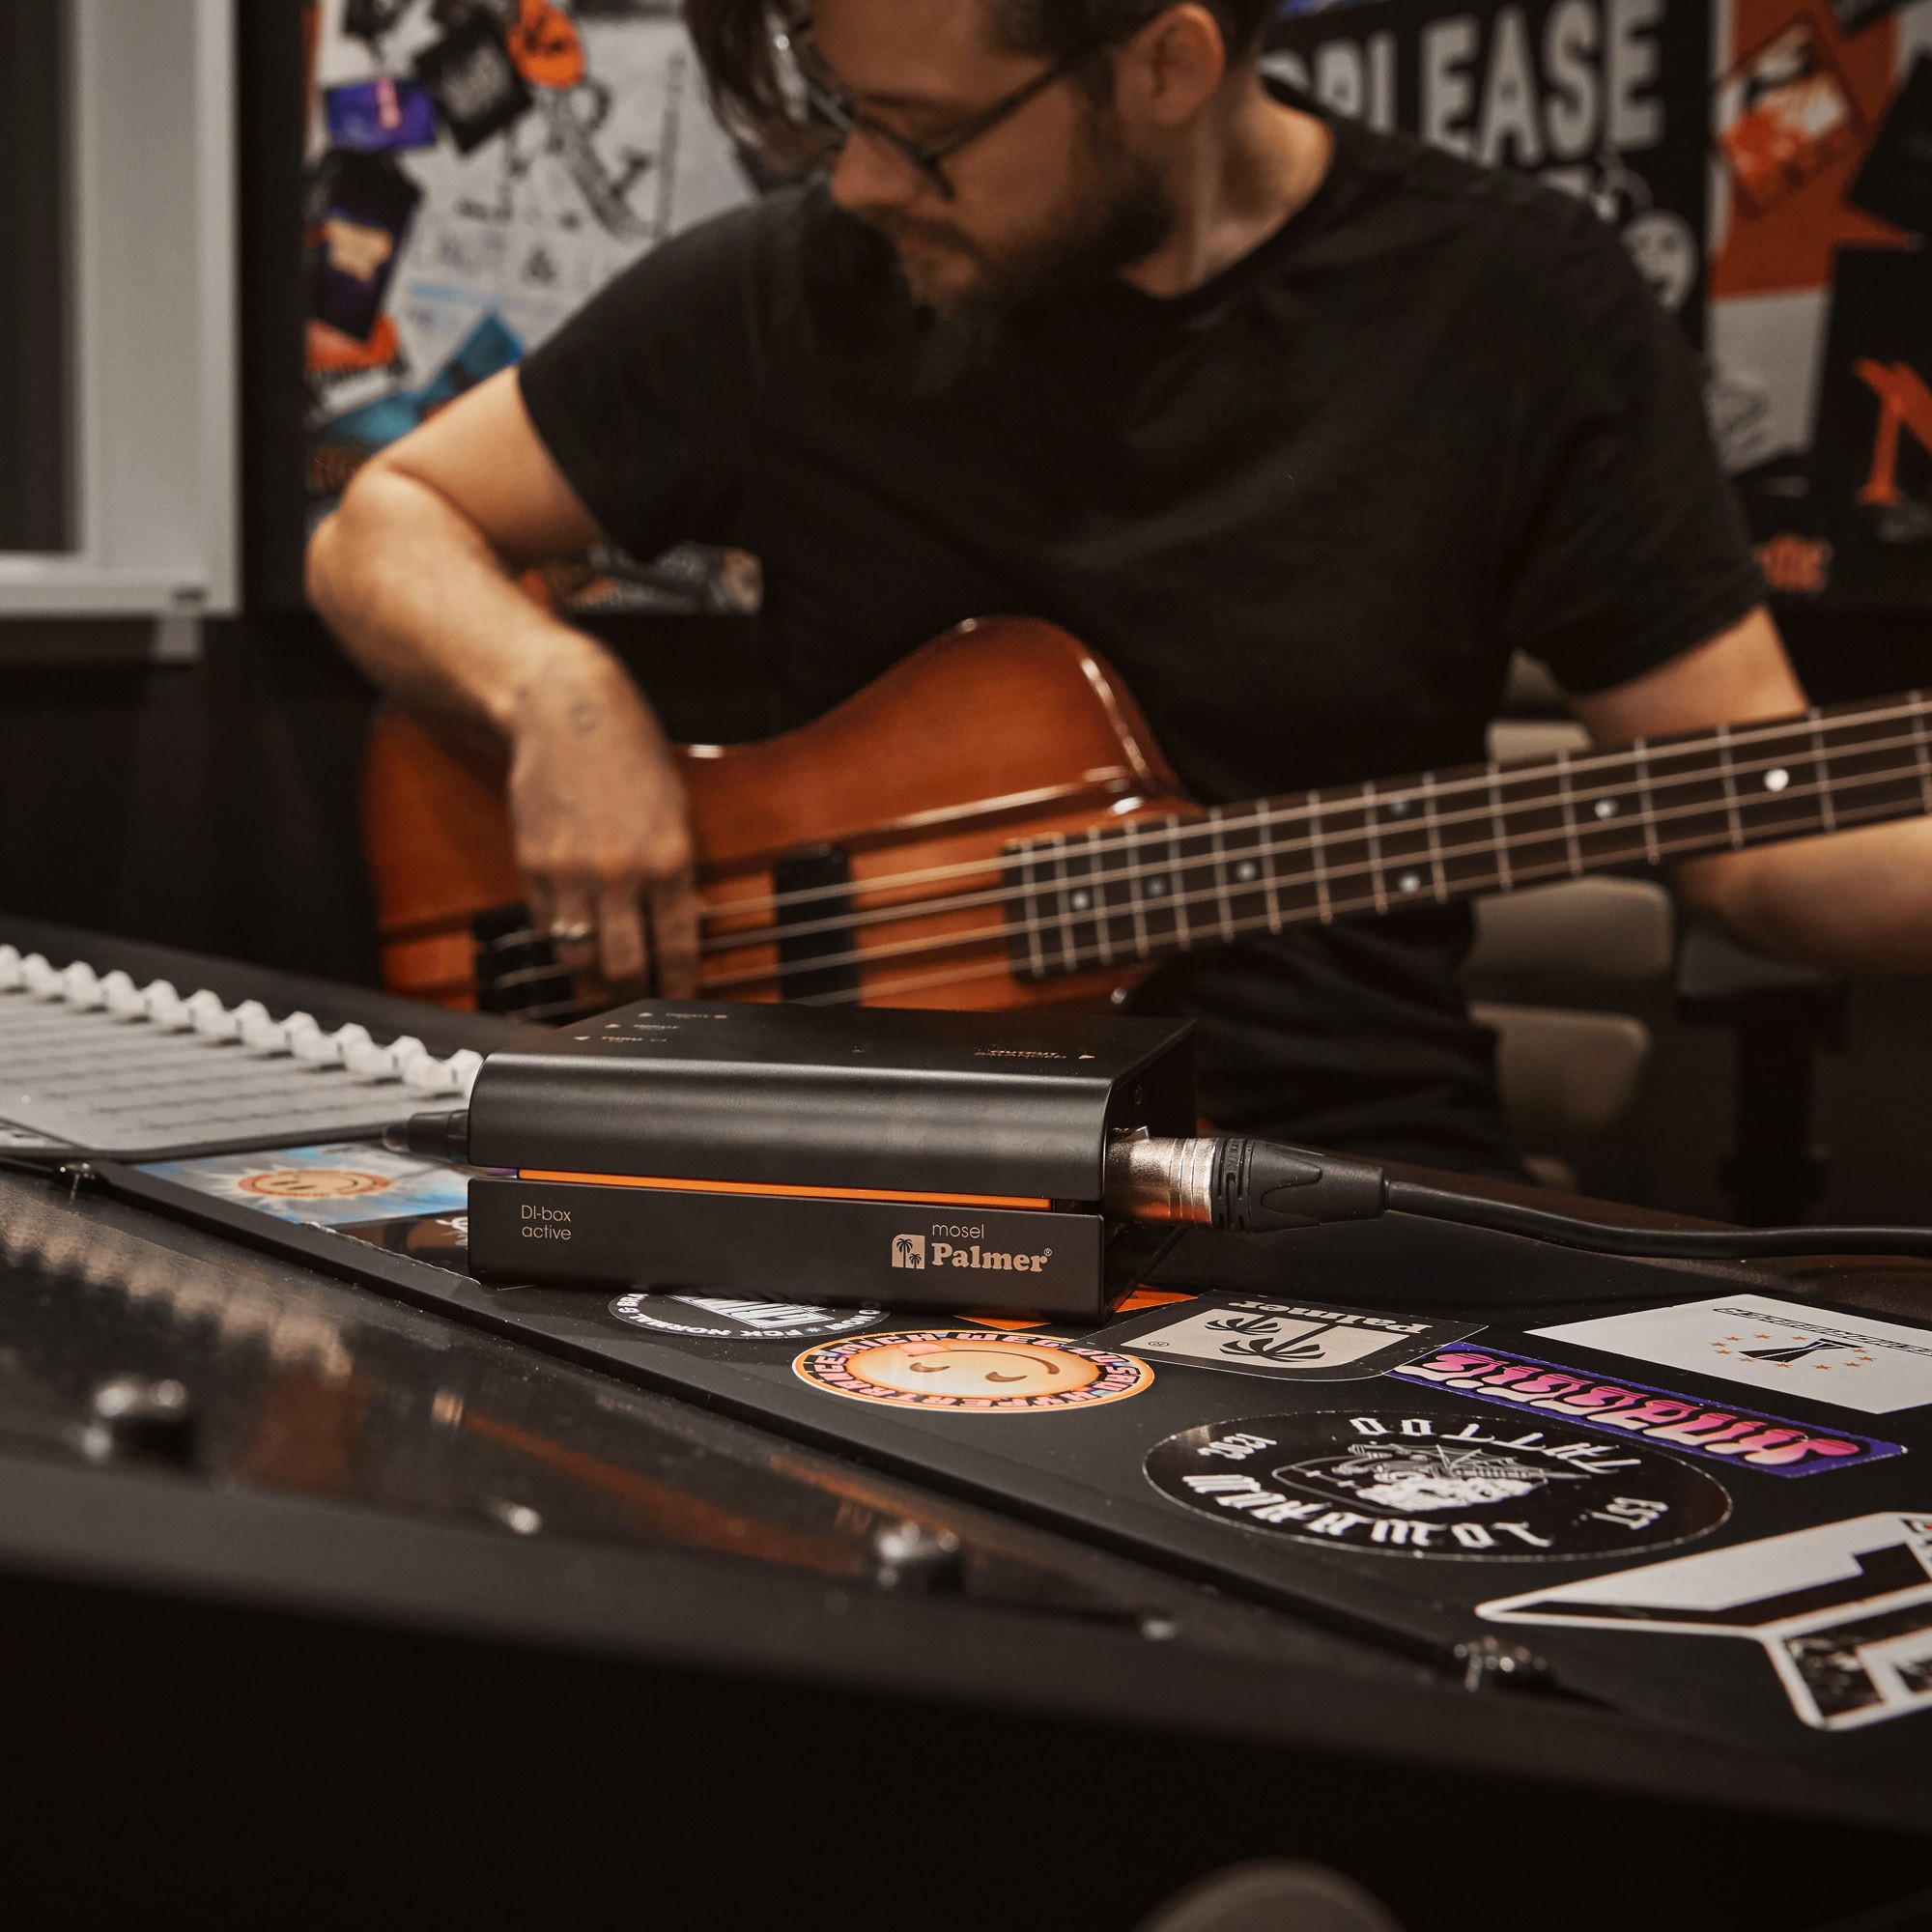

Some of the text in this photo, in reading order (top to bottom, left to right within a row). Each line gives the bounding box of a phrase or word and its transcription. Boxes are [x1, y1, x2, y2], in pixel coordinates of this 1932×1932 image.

[522, 1205, 571, 1222] DI-box
[522, 1224, 572, 1240] active
[932, 1223, 984, 1238] mosel
[629, 1313, 732, 1337] NORMAL
[1228, 1300, 1432, 1335] Palmer
[831, 1333, 939, 1354] MICH
[955, 1333, 1068, 1348] WEG
[813, 1355, 1101, 1407] HYPERTRANCE
[1093, 1365, 1141, 1391] SAU
